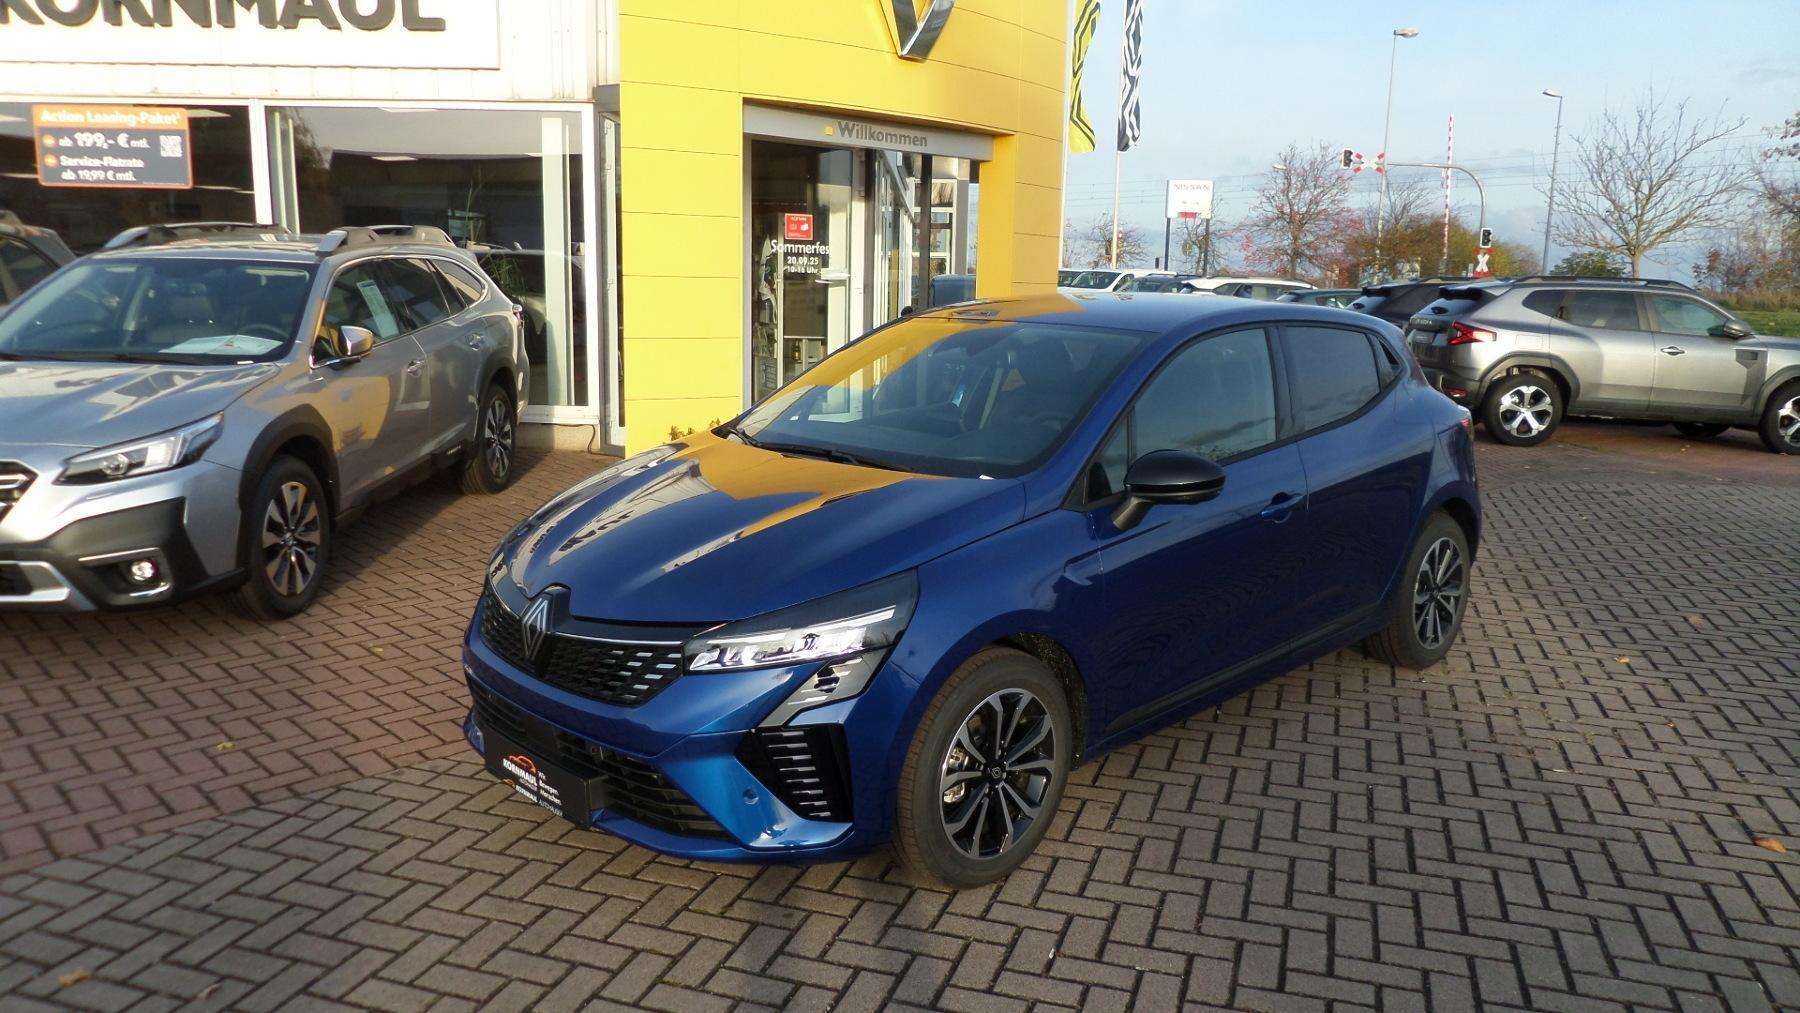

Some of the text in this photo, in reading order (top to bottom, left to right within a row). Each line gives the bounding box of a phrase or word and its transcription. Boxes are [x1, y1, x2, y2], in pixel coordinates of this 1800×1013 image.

[837, 119, 928, 147] Willkommen
[58, 135, 73, 147] ab
[116, 132, 130, 148] €
[60, 169, 76, 181] ab
[106, 170, 116, 181] €
[787, 256, 819, 266] 20.09.25
[806, 266, 818, 274] Uhr
